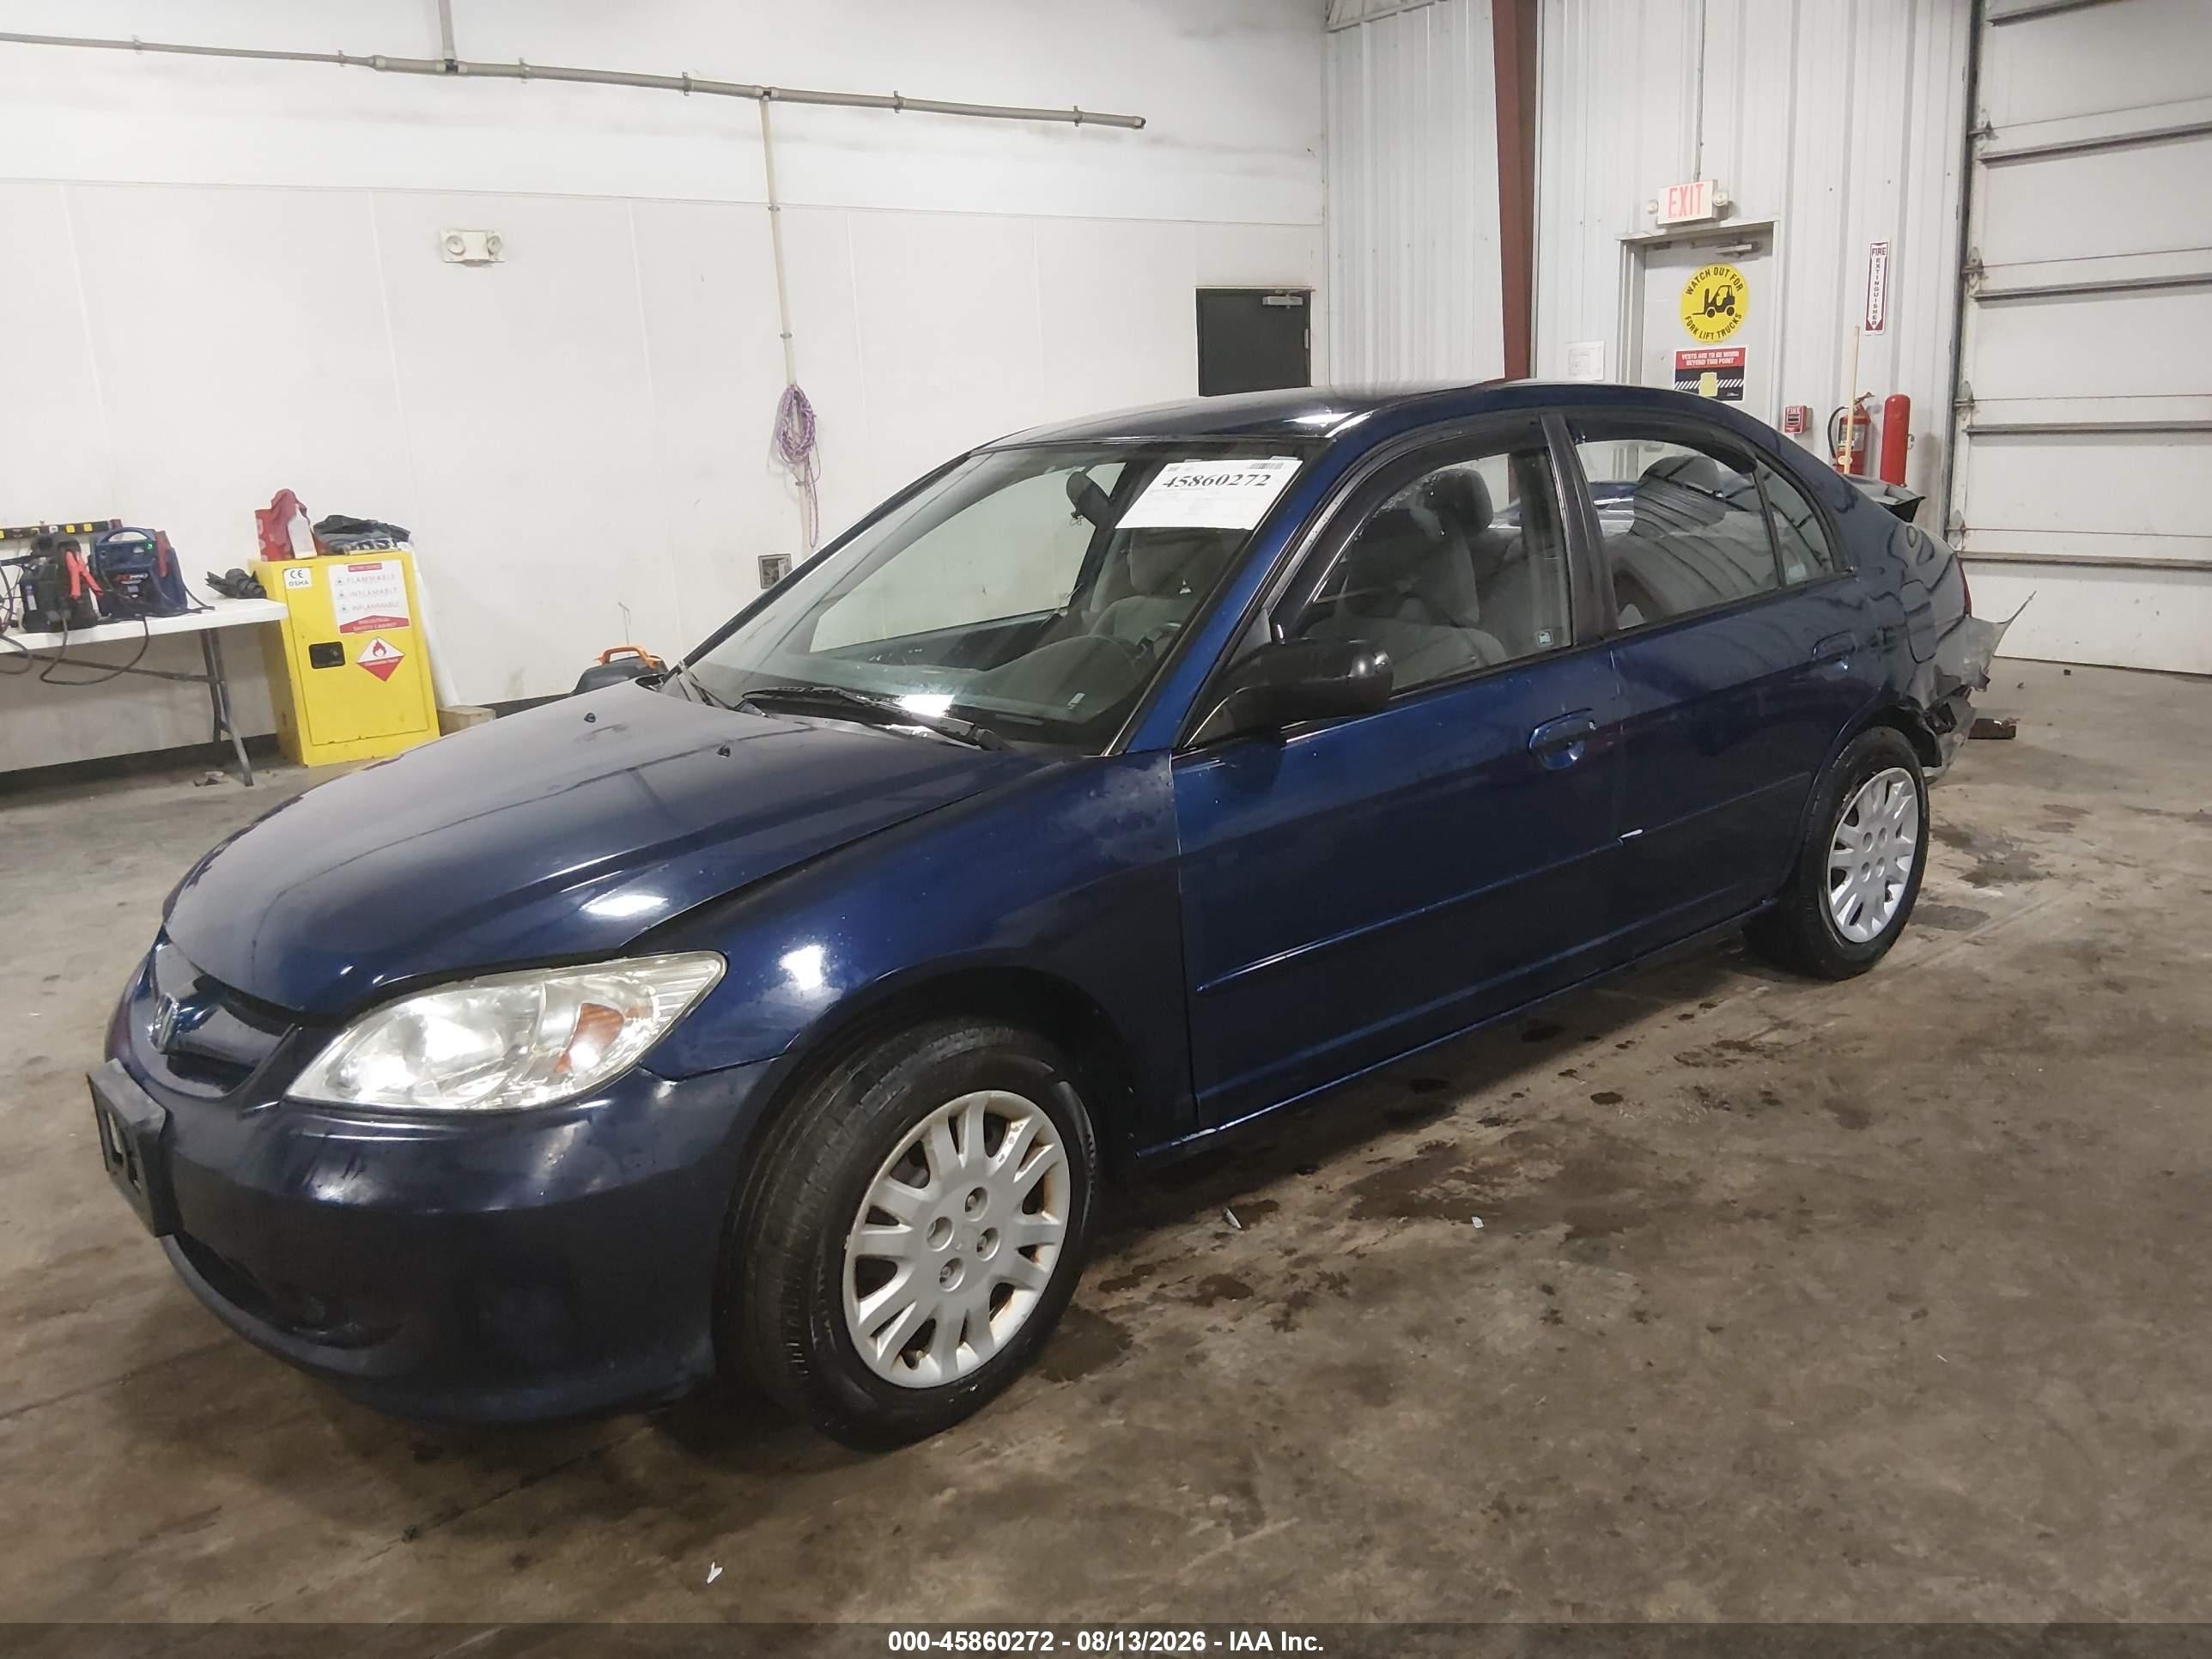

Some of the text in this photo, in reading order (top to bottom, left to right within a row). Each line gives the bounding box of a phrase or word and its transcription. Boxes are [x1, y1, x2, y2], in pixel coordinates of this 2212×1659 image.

[1668, 184, 1704, 218] EXIT
[1872, 247, 1887, 256] FIRE
[1686, 267, 1743, 295] WATCH OUT FOR
[1871, 258, 1881, 325] EXTINGUISHER
[1685, 313, 1741, 340] FORK LIFT TRUCKS
[1162, 474, 1271, 488] 45860272
[347, 574, 395, 583] FLAMMABLE
